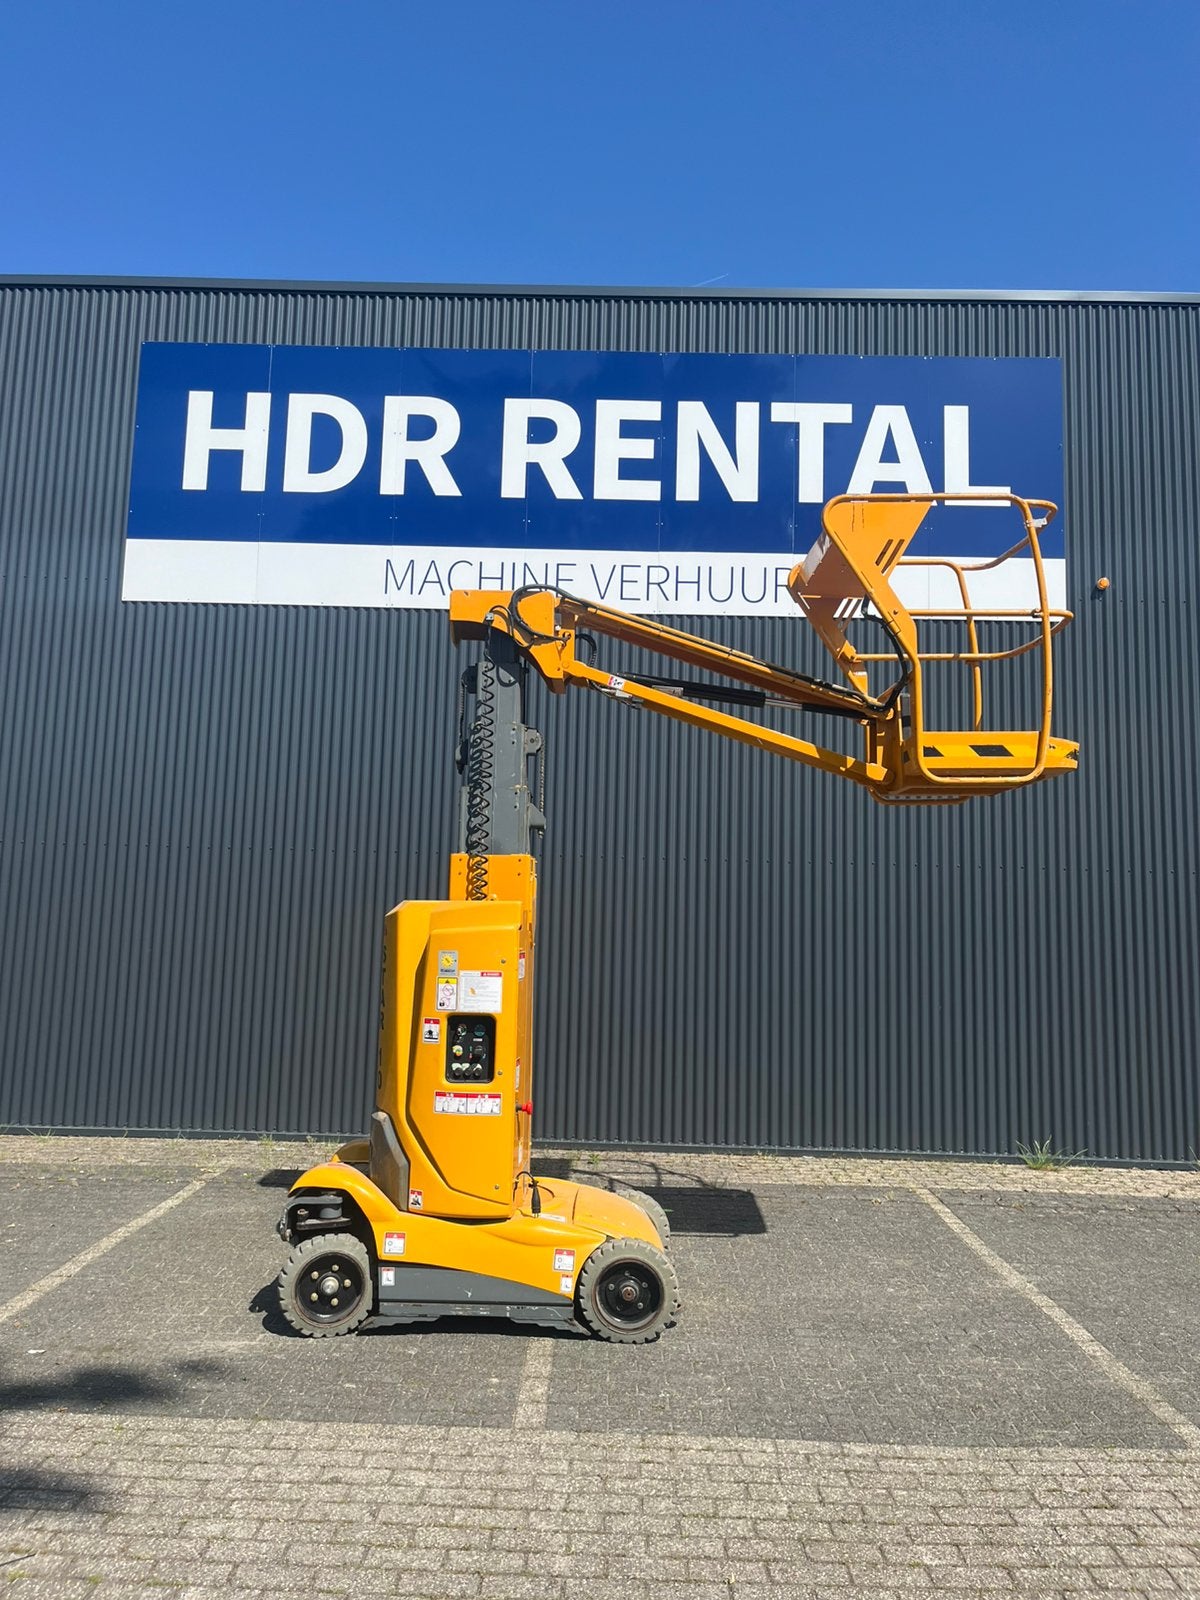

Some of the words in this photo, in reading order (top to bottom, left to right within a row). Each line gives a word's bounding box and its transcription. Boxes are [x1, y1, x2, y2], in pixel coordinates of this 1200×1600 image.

[182, 390, 462, 497] HDR
[500, 398, 1012, 507] RENTAL
[384, 558, 577, 597] MACHINE
